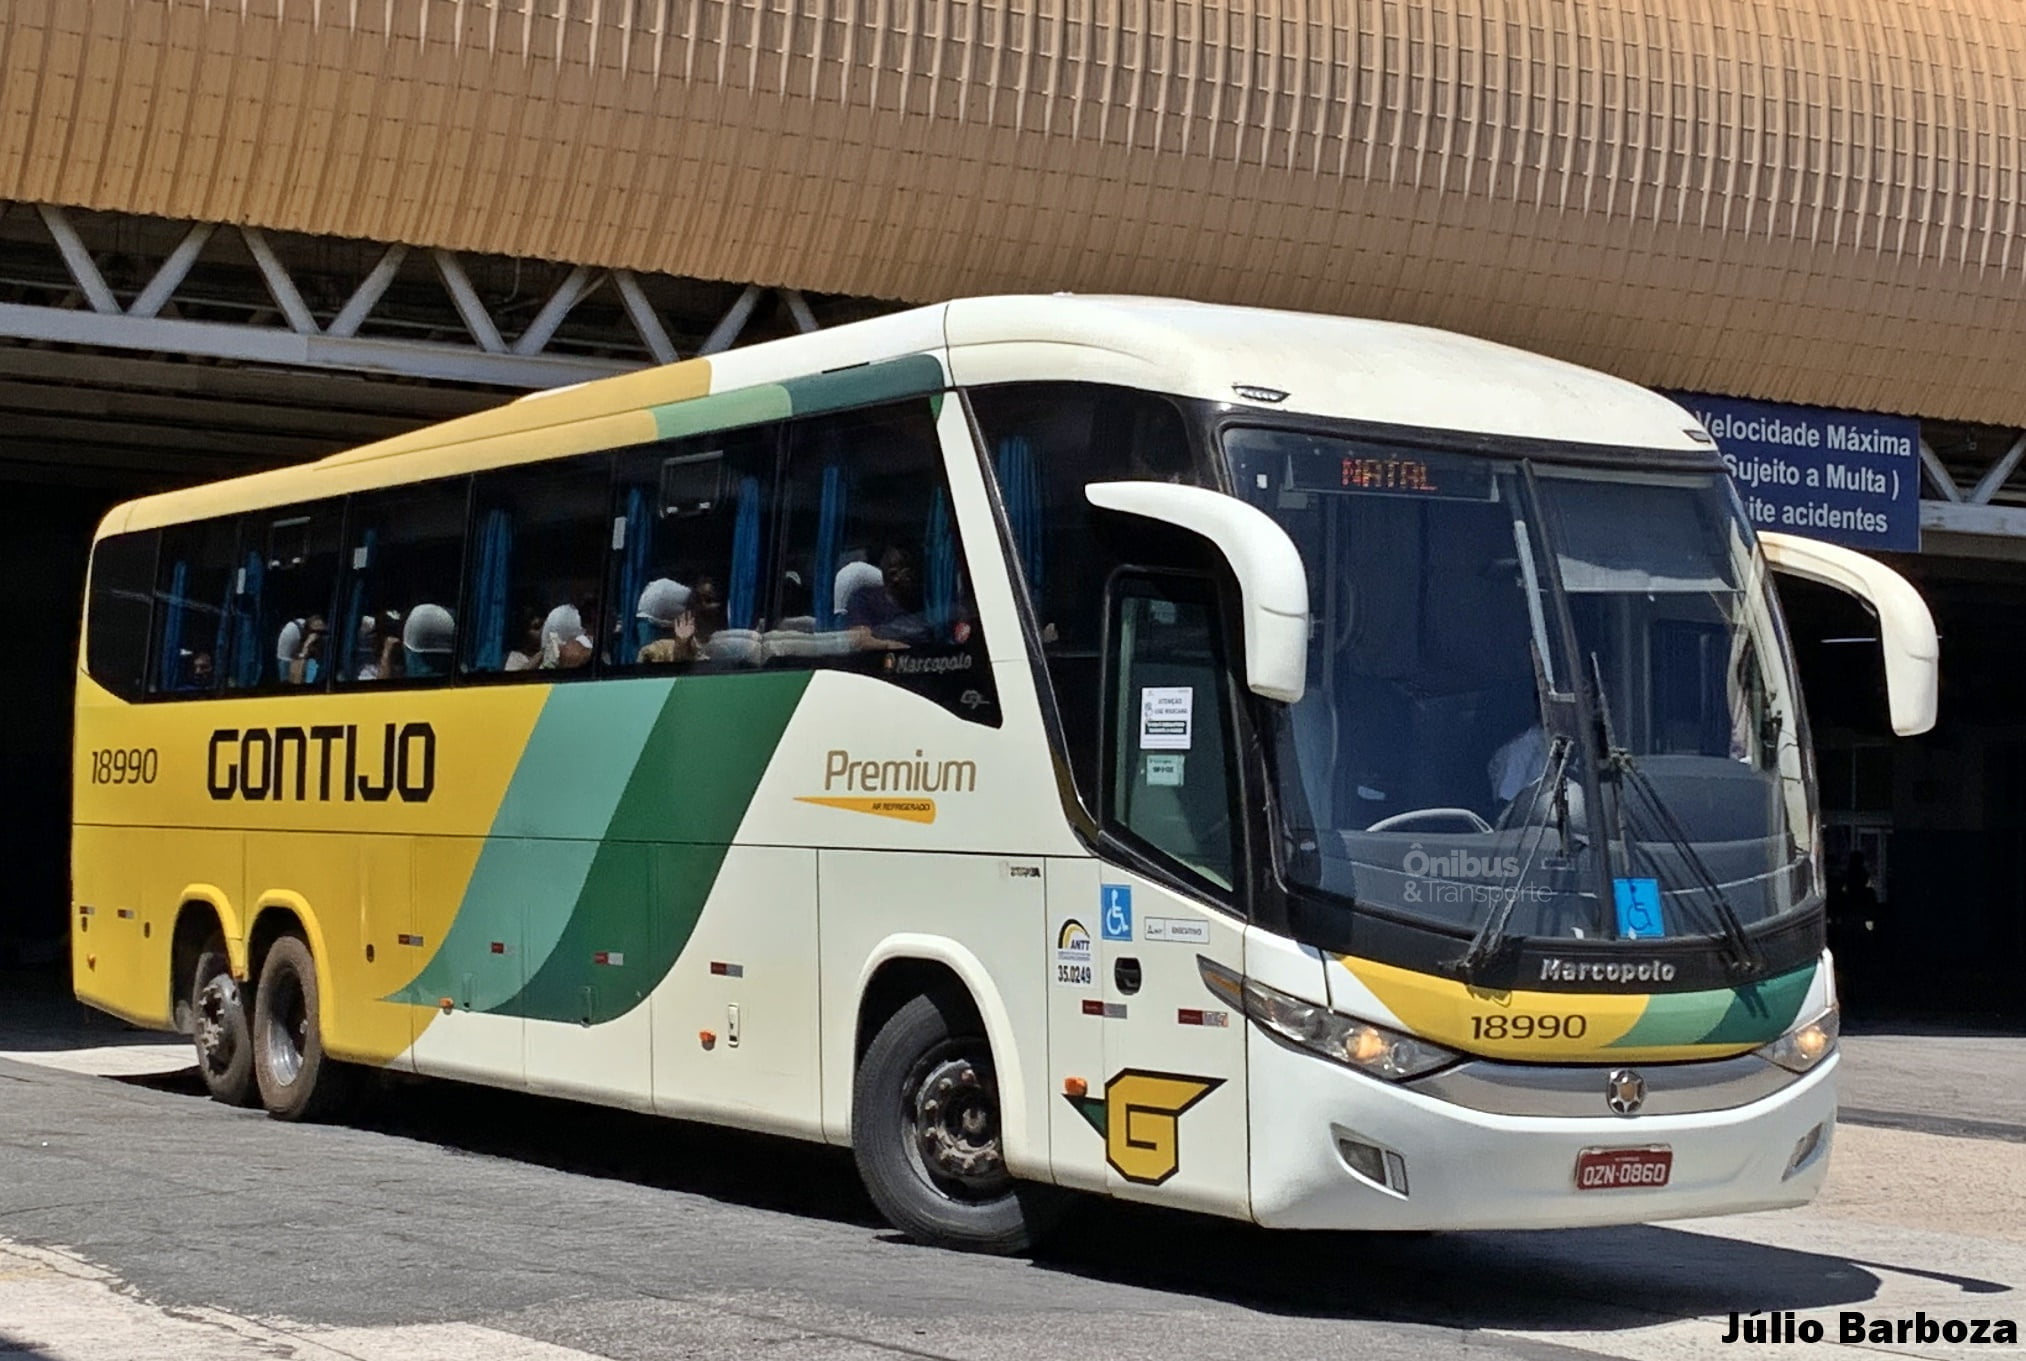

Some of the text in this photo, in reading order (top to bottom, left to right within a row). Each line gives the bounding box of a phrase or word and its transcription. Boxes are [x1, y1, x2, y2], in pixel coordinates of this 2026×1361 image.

[1696, 410, 1912, 457] Velocidade Máxima
[1341, 457, 1438, 491] NATAL
[1723, 453, 1800, 488] Sujeito
[1805, 469, 1820, 488] a
[1826, 463, 1886, 494] Multa
[1746, 496, 1889, 533] ite acidentes
[896, 652, 973, 675] Marcopolo
[91, 747, 158, 785] 18990
[207, 722, 437, 803] GONTIJO
[824, 749, 977, 793] Premium
[1070, 939, 1091, 951] ANTT
[1540, 958, 1677, 984] Marcopolo
[1471, 1014, 1587, 1040] 18990
